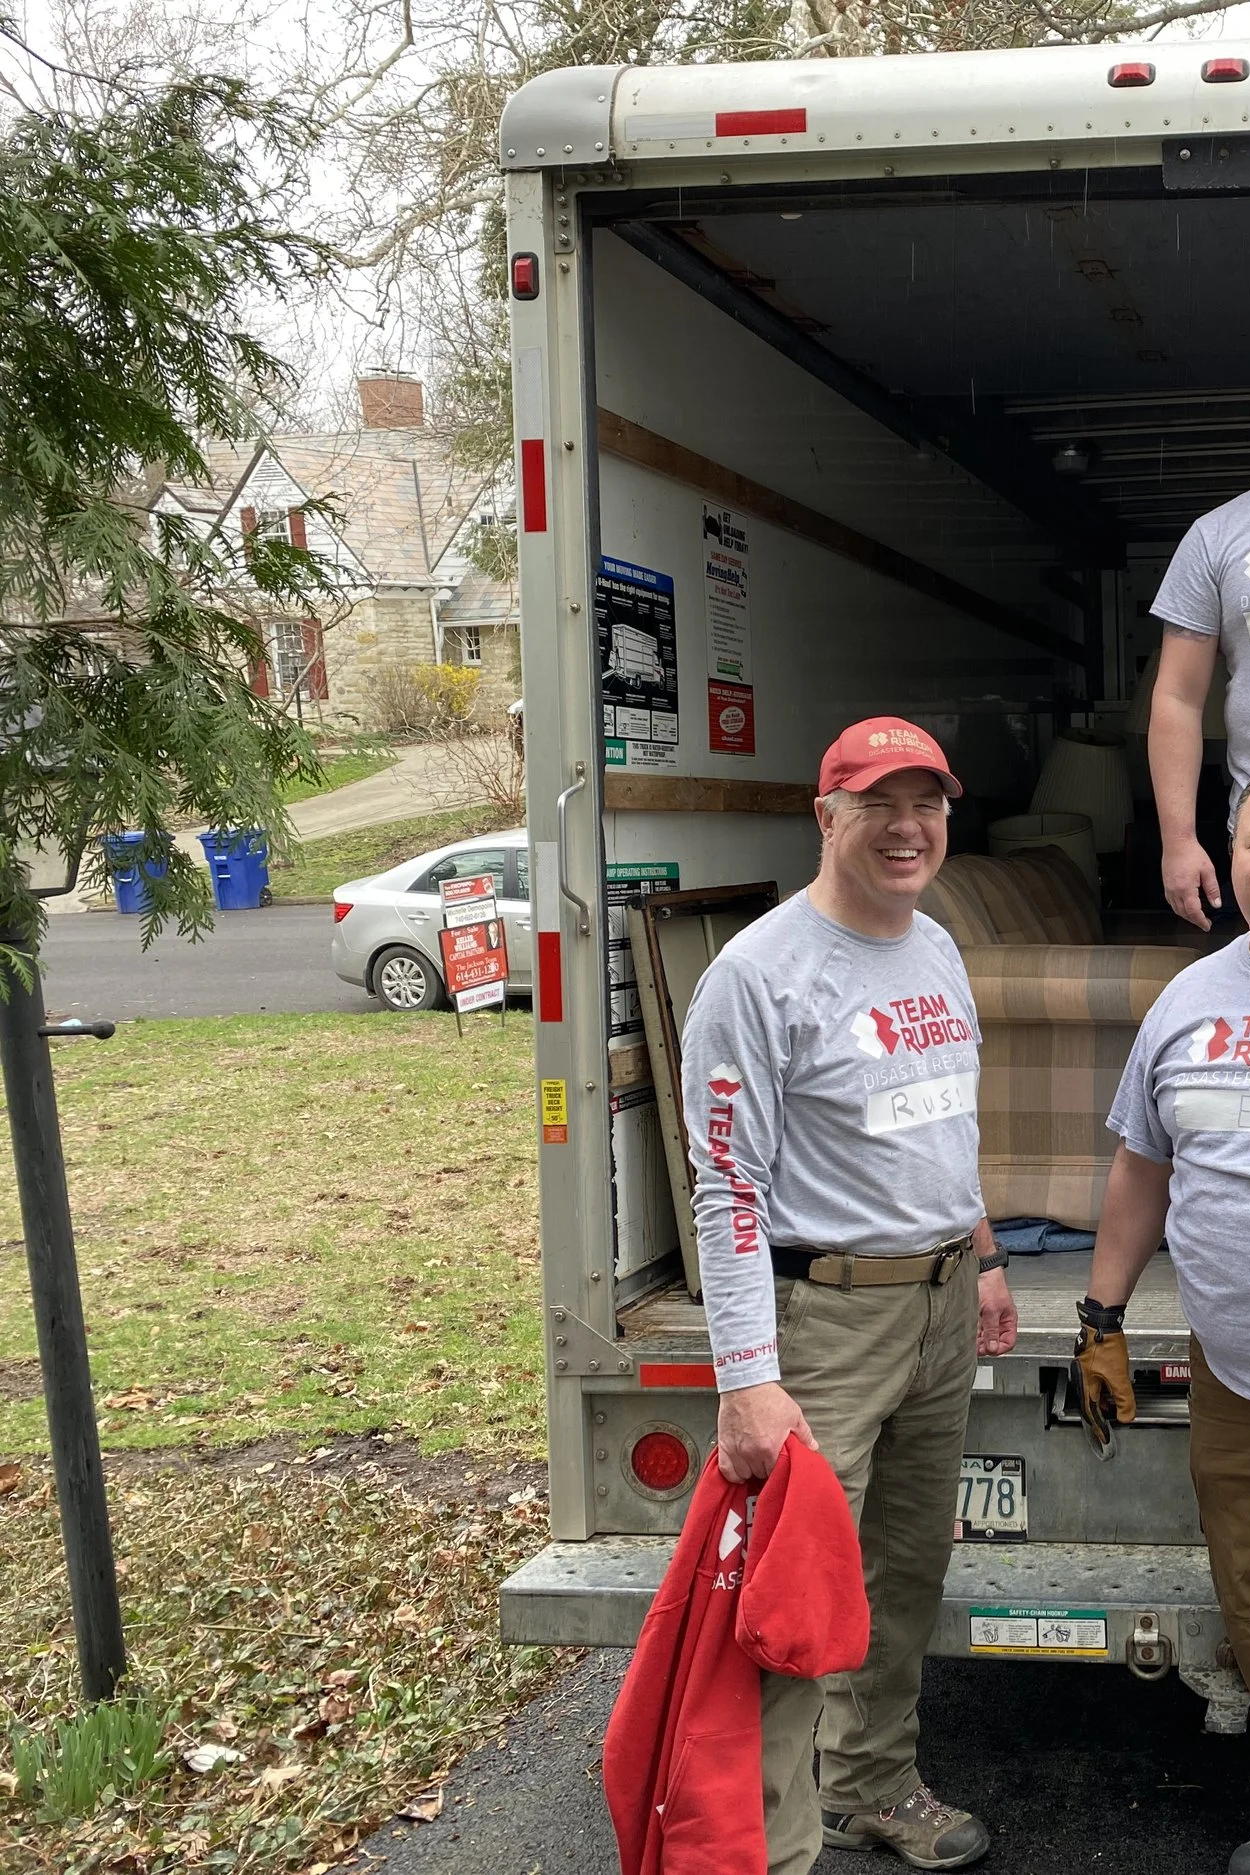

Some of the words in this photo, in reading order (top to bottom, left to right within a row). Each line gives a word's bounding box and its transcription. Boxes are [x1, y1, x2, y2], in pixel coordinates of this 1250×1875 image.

[888, 729, 918, 740] TEAM
[868, 747, 905, 757] DISASTER
[890, 737, 933, 754] RUBICON
[451, 929, 461, 938] For
[467, 926, 479, 935] Sale
[456, 963, 466, 972] The
[466, 960, 485, 970] Jackson
[460, 995, 475, 1007] UNDER
[476, 988, 501, 1003] CONTRACT
[889, 994, 951, 1025] TEAM
[932, 1051, 973, 1073] RESPO
[707, 1103, 736, 1171] TEAM
[959, 1477, 1015, 1519] 778
